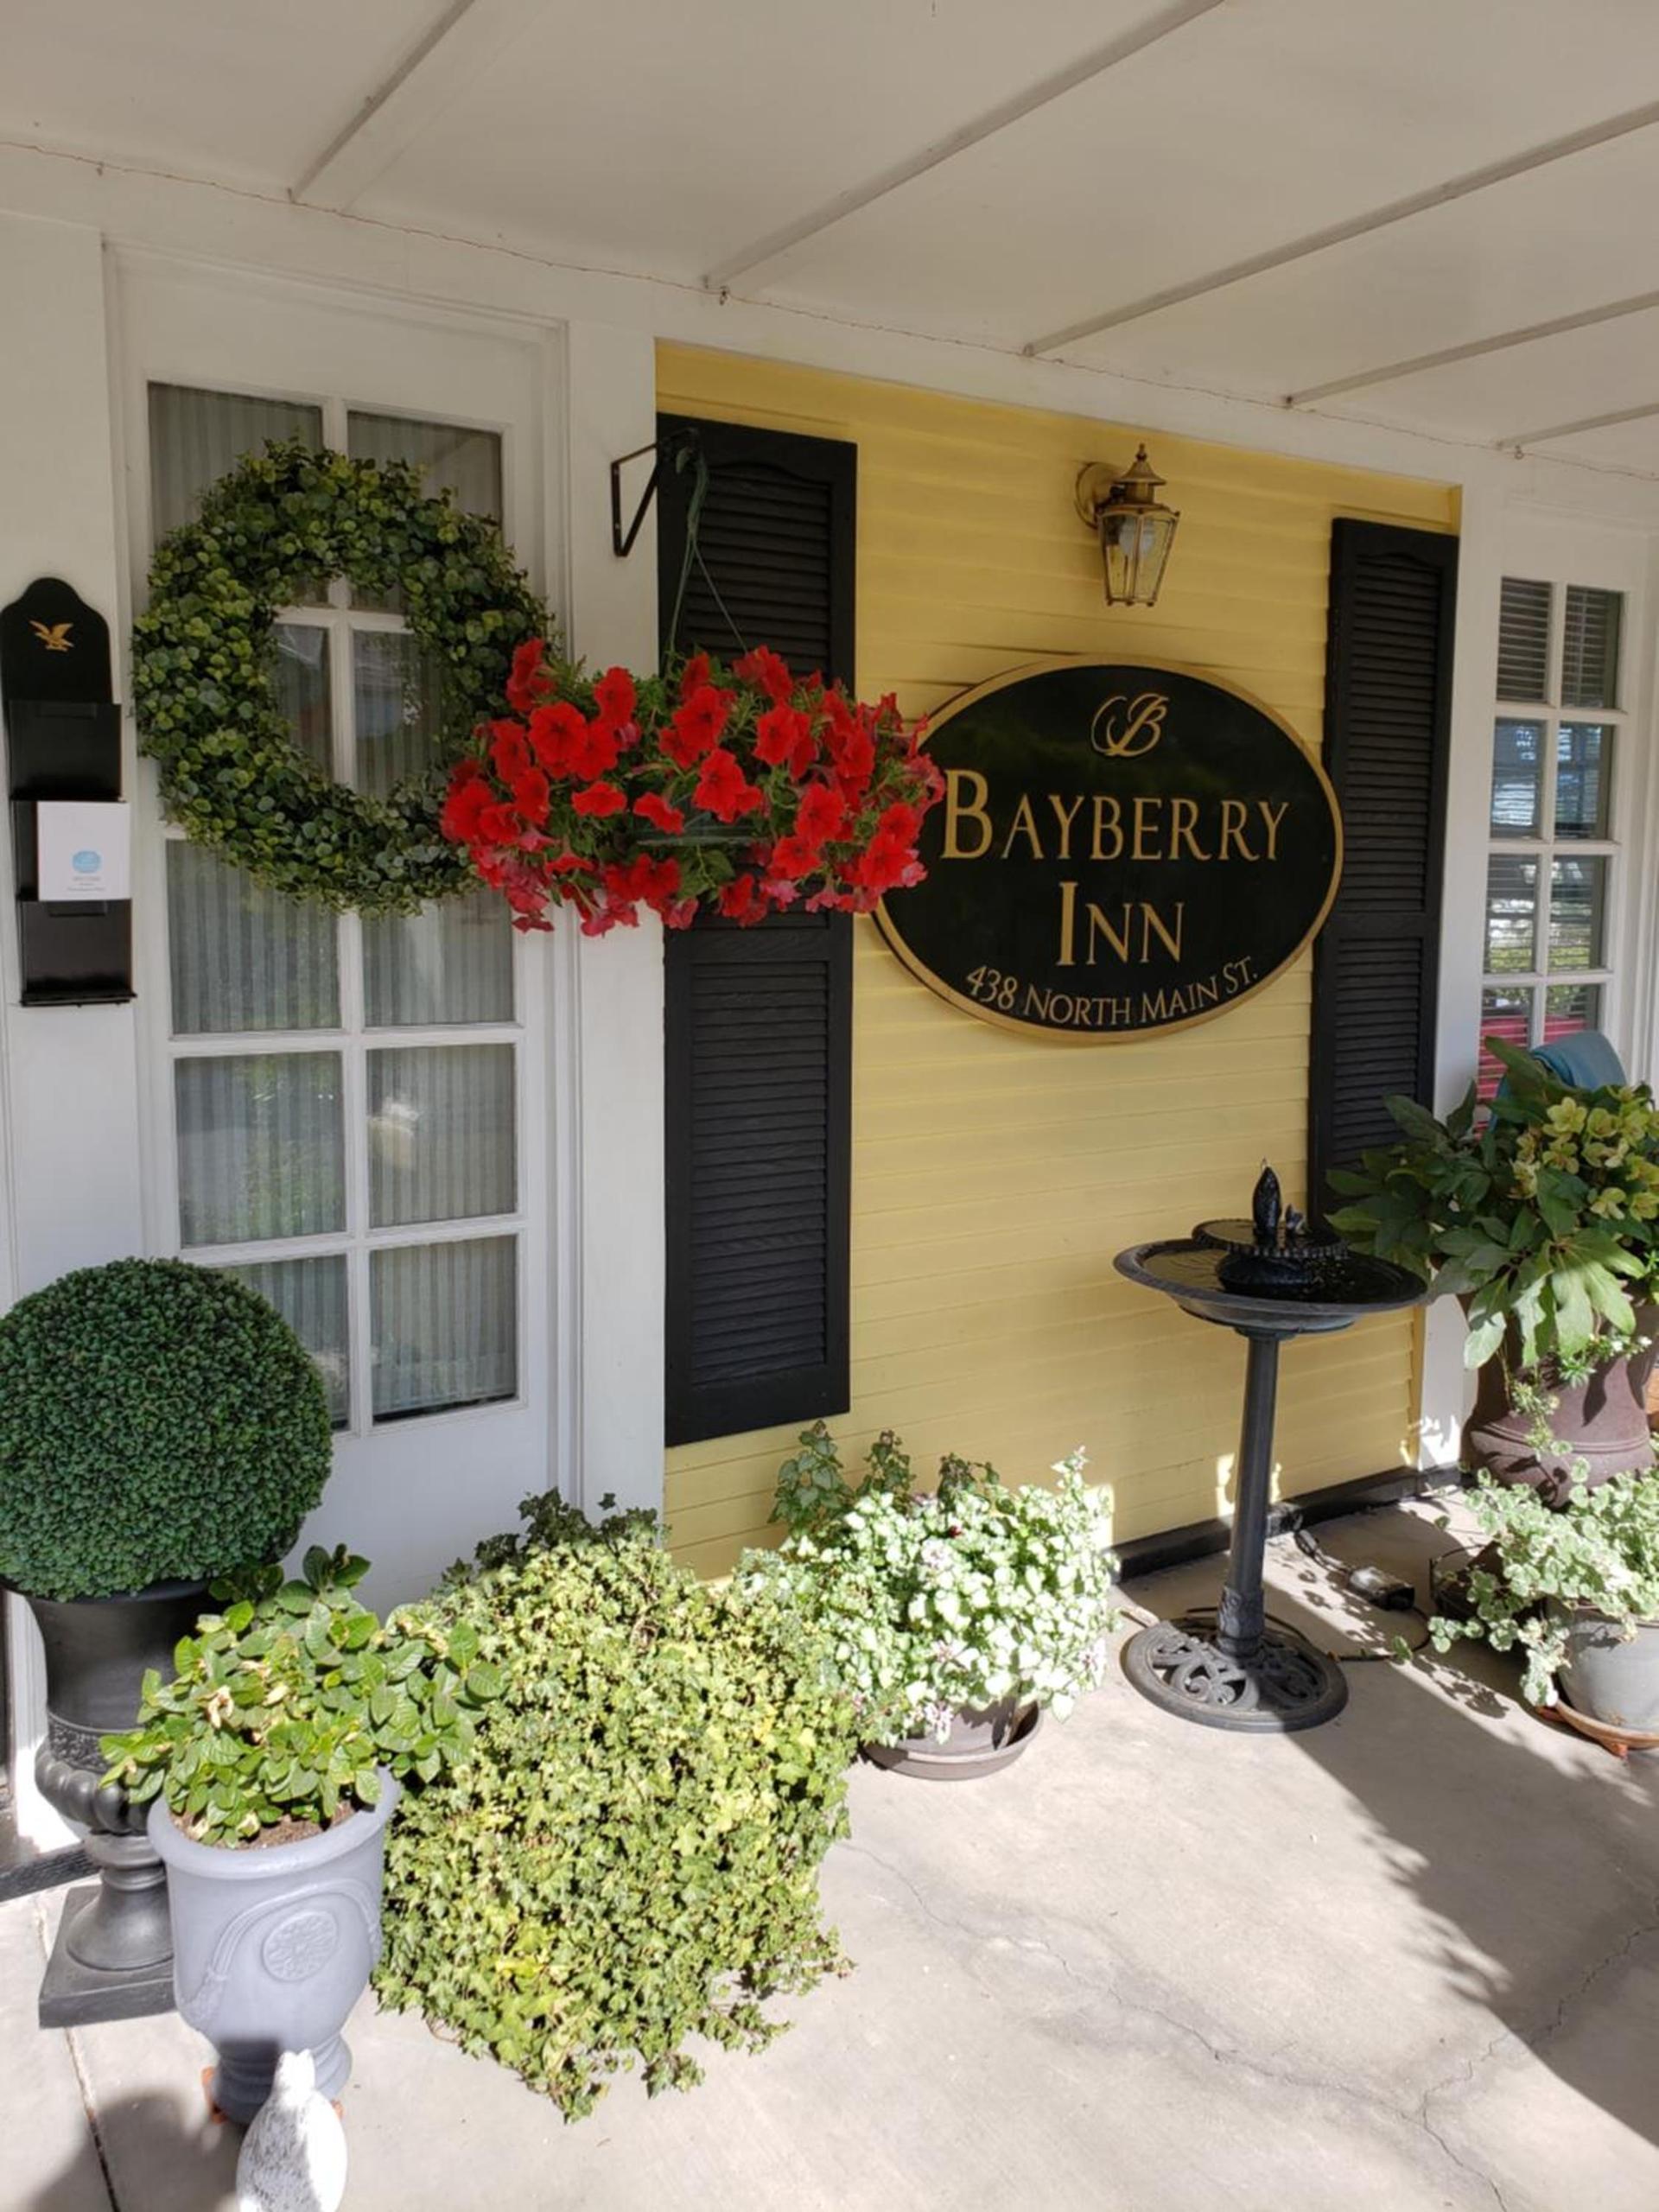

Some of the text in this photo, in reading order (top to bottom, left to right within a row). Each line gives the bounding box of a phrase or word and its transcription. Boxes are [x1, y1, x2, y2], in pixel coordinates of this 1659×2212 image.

[1091, 693, 1168, 757] B
[941, 769, 1288, 861] BAYBERRY
[1057, 881, 1185, 965] INN
[966, 956, 1259, 1026] 438 NORTH MAIN ST.
